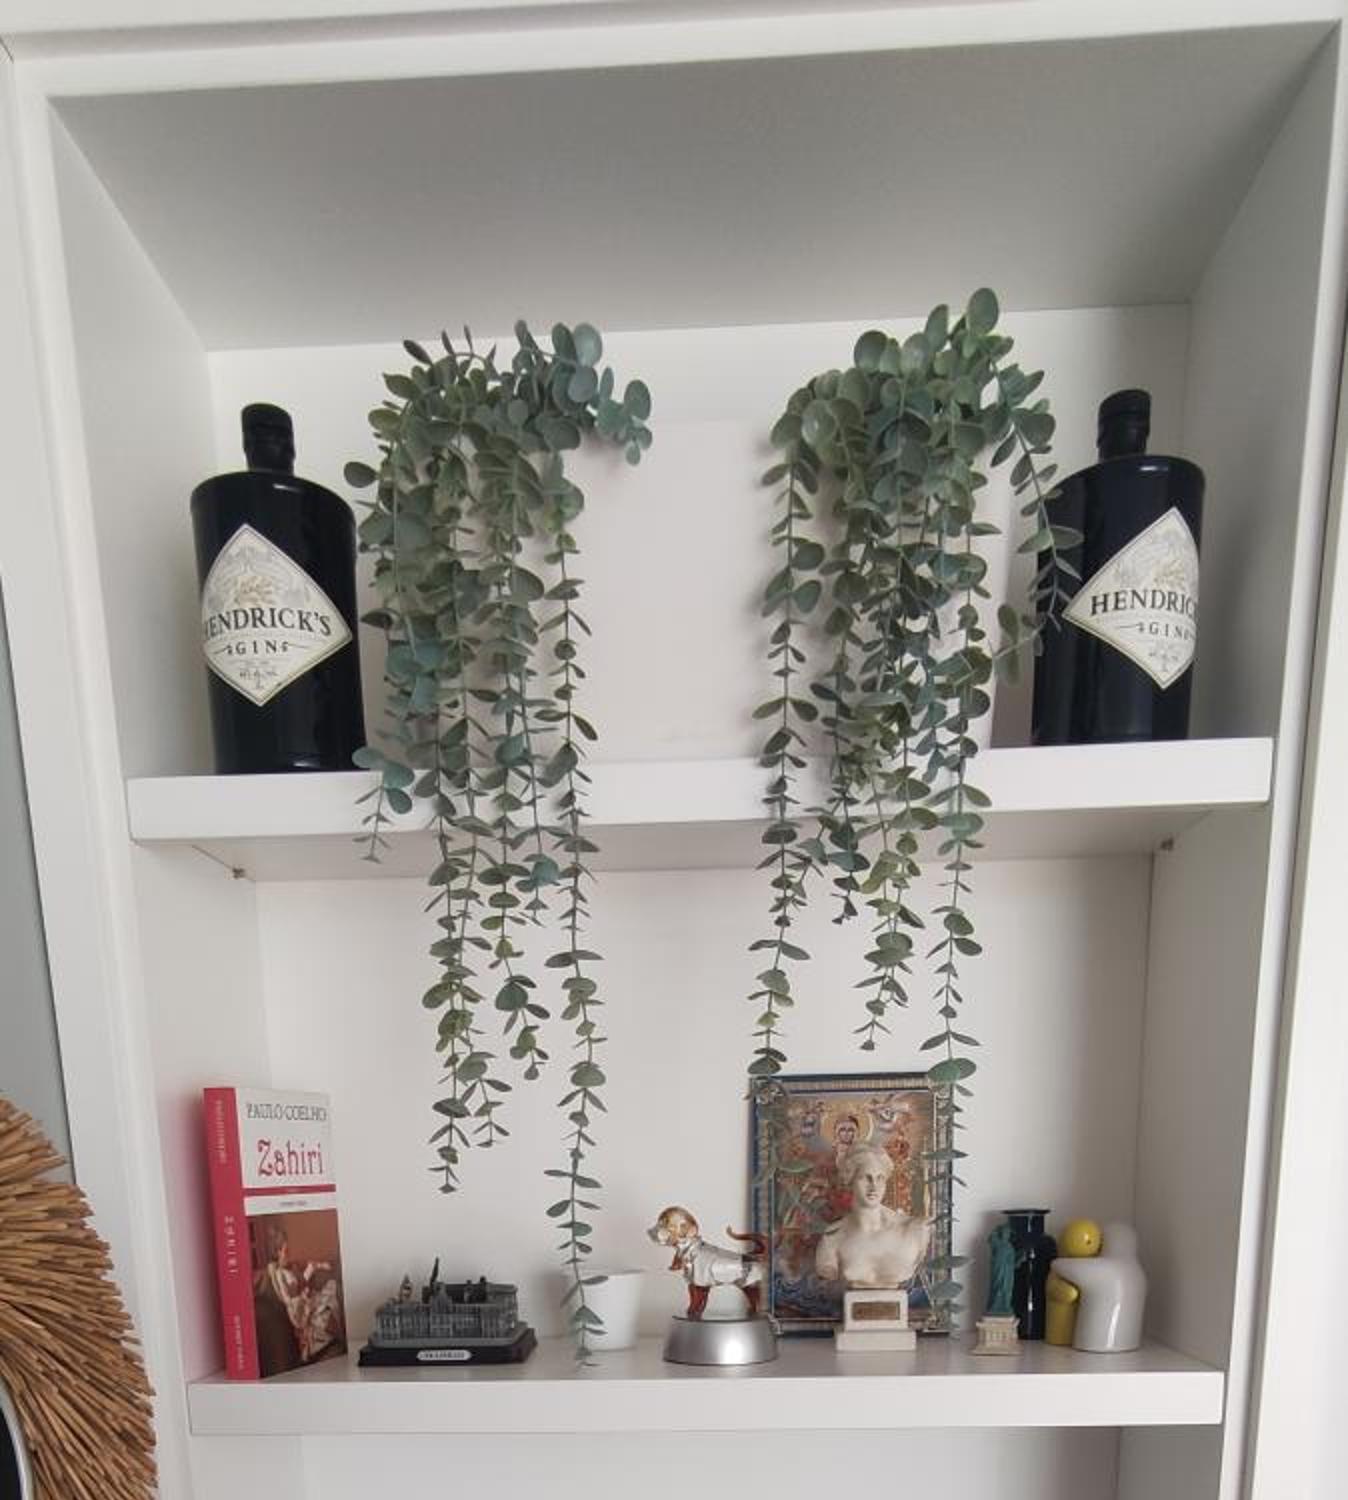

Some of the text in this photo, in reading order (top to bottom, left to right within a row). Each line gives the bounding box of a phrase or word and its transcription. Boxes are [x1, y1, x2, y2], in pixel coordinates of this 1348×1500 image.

[1090, 588, 1197, 618] HENDRIC
[206, 606, 332, 638] ENDRICK'S
[235, 639, 277, 655] GIN
[286, 1104, 327, 1121] COELHO
[257, 1138, 324, 1177] Zahiri
